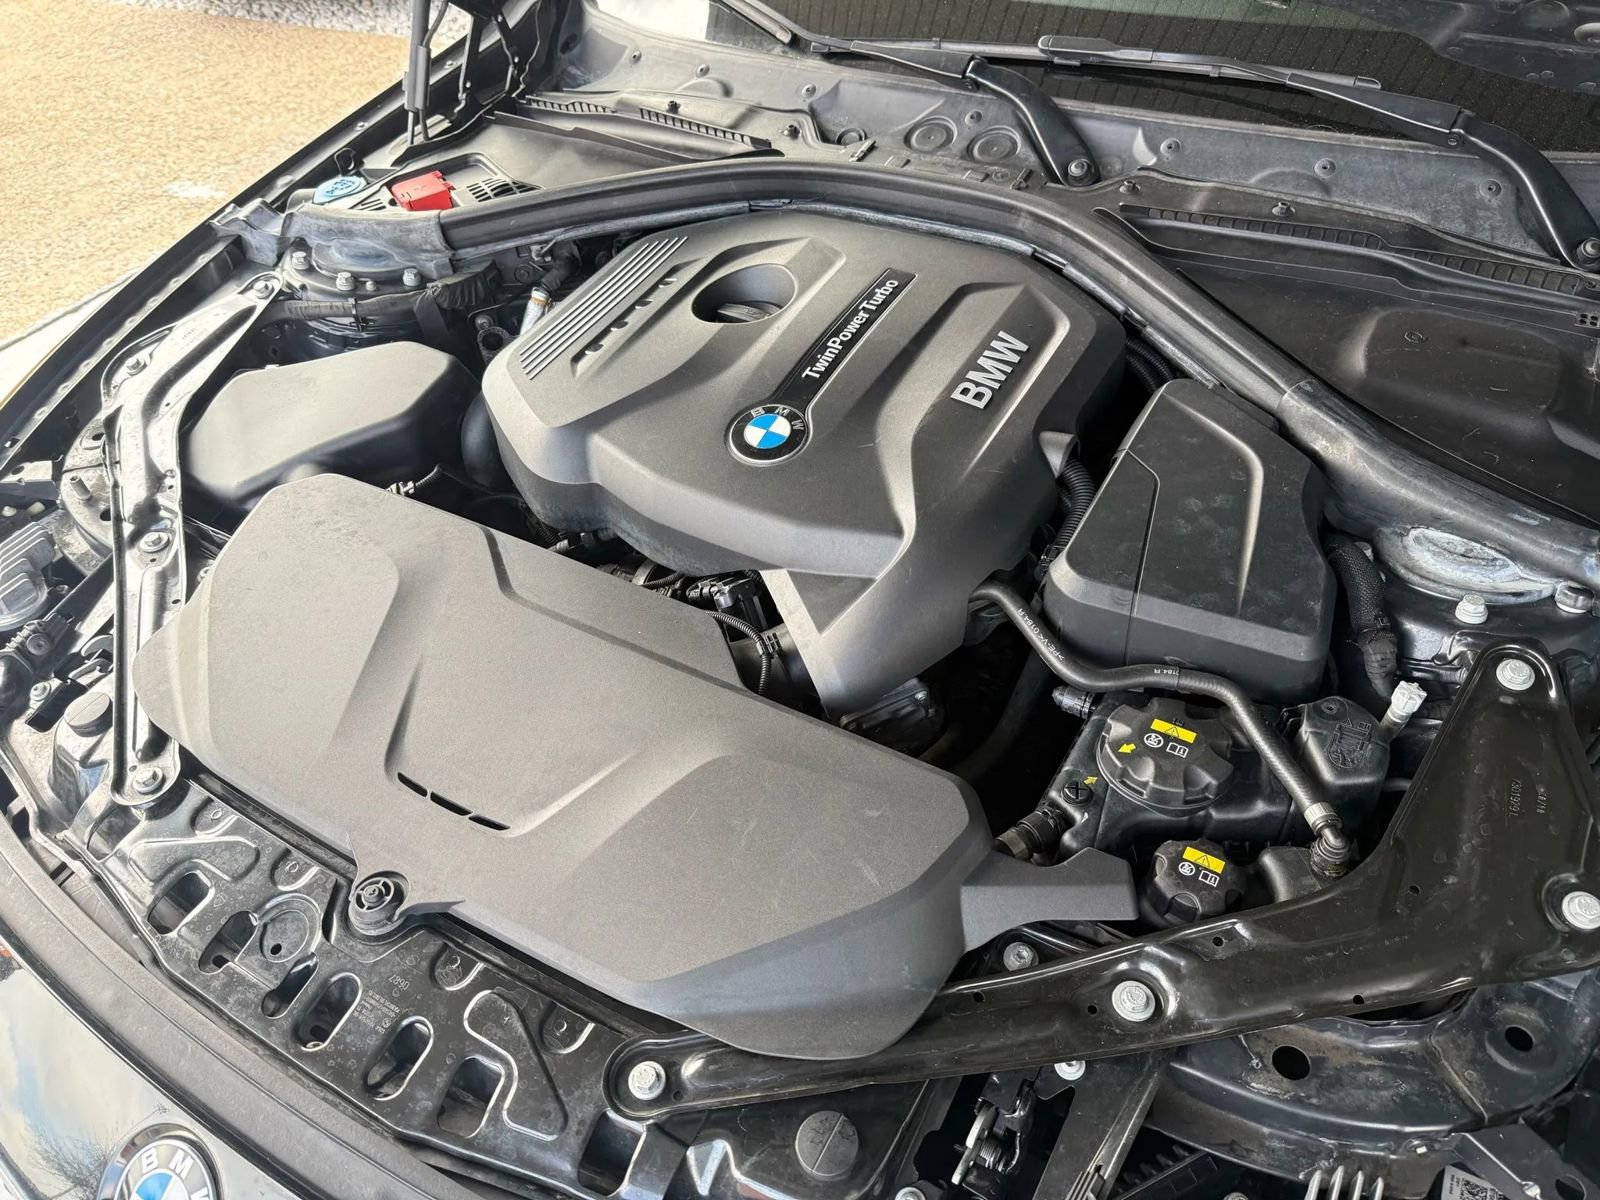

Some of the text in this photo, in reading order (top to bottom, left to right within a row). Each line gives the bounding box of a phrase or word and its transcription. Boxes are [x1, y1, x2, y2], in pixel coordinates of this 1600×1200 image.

[950, 330, 1029, 409] BMW
[750, 405, 805, 431] BMW
[388, 974, 410, 991] 0687
